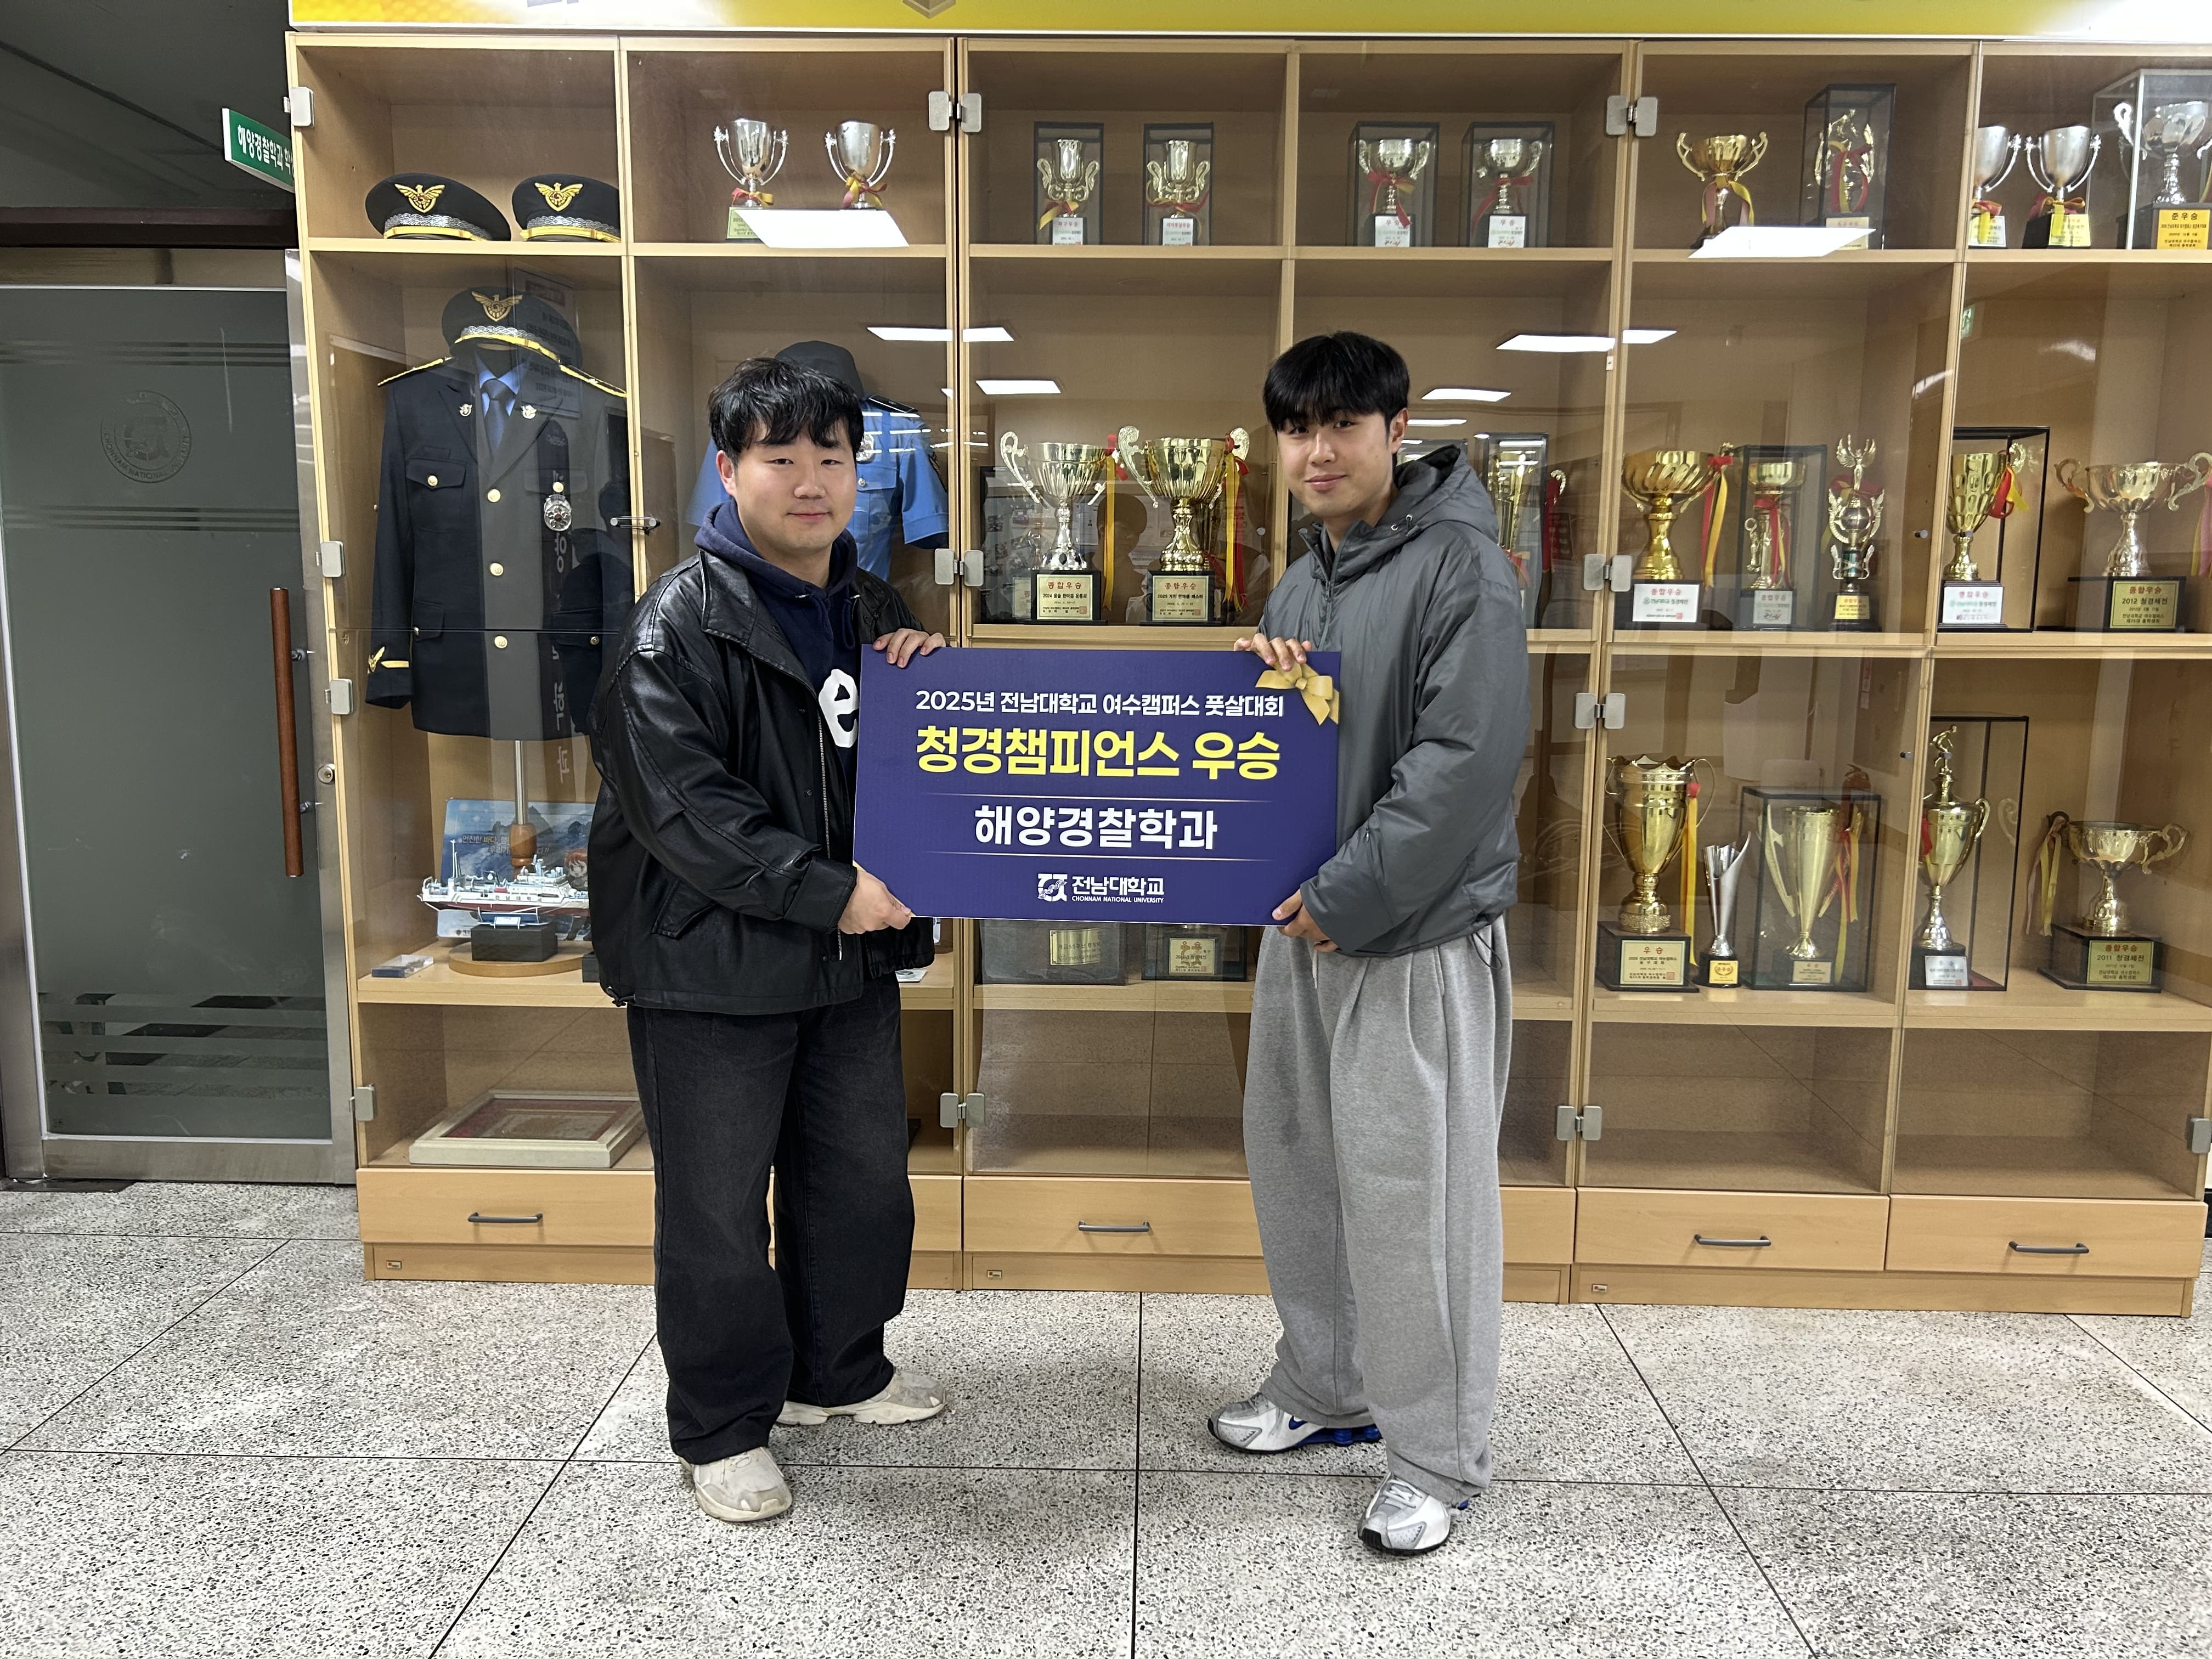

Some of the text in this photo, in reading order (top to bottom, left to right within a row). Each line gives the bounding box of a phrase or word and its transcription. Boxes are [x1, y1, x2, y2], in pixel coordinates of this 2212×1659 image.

[238, 125, 294, 177] 해양경찰학과 학
[2130, 586, 2162, 594] 종합우승
[916, 690, 1283, 717] 2025년 전남대학교 여수캠퍼스 풋살대회
[917, 725, 1280, 780] 청경챔피언스 우승
[974, 805, 1218, 850] 해양경찰학과
[1072, 876, 1165, 896] 전남대학교
[1643, 946, 1663, 955] 우승
